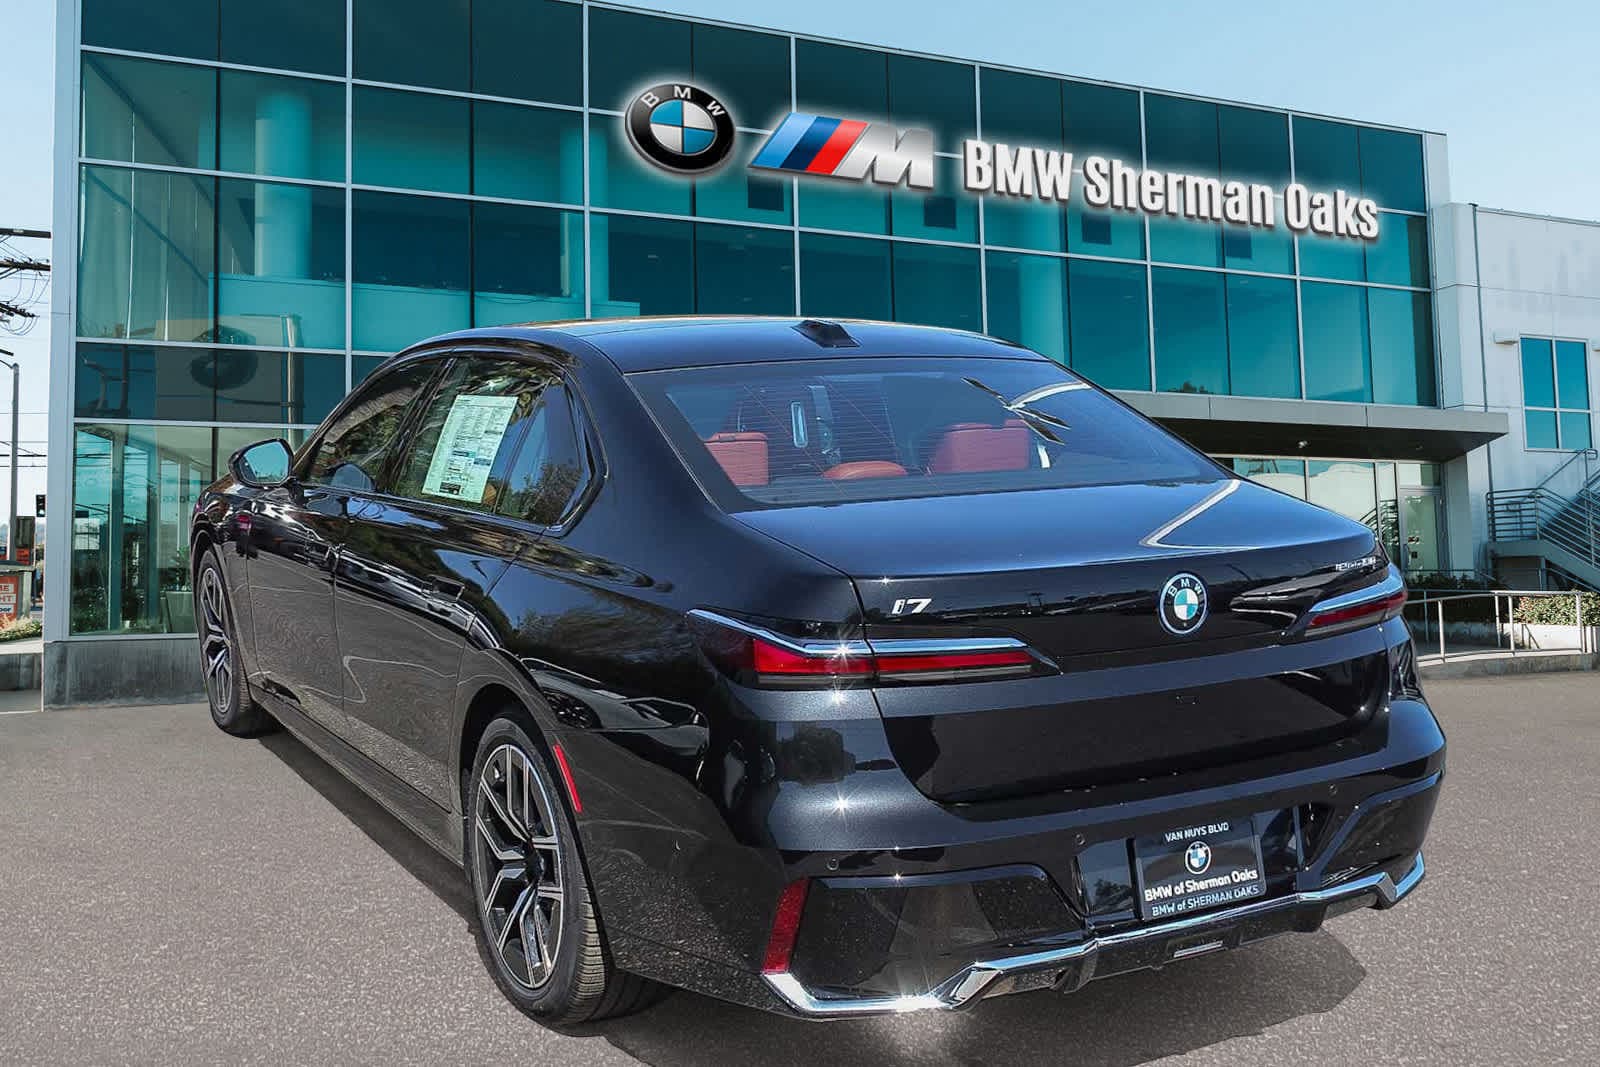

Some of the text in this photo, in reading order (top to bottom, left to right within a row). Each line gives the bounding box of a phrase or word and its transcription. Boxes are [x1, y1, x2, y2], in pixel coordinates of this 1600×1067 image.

[640, 85, 726, 117] BMW
[963, 138, 1380, 241] BMW Sherman Oaks
[1167, 577, 1203, 597] BMW
[891, 598, 932, 615] i7
[1165, 821, 1230, 842] VAN NUYS BLVD
[1144, 868, 1258, 902] BMW of Sherman Oaks
[1152, 885, 1260, 917] BMW of SHERMAN OAKS
